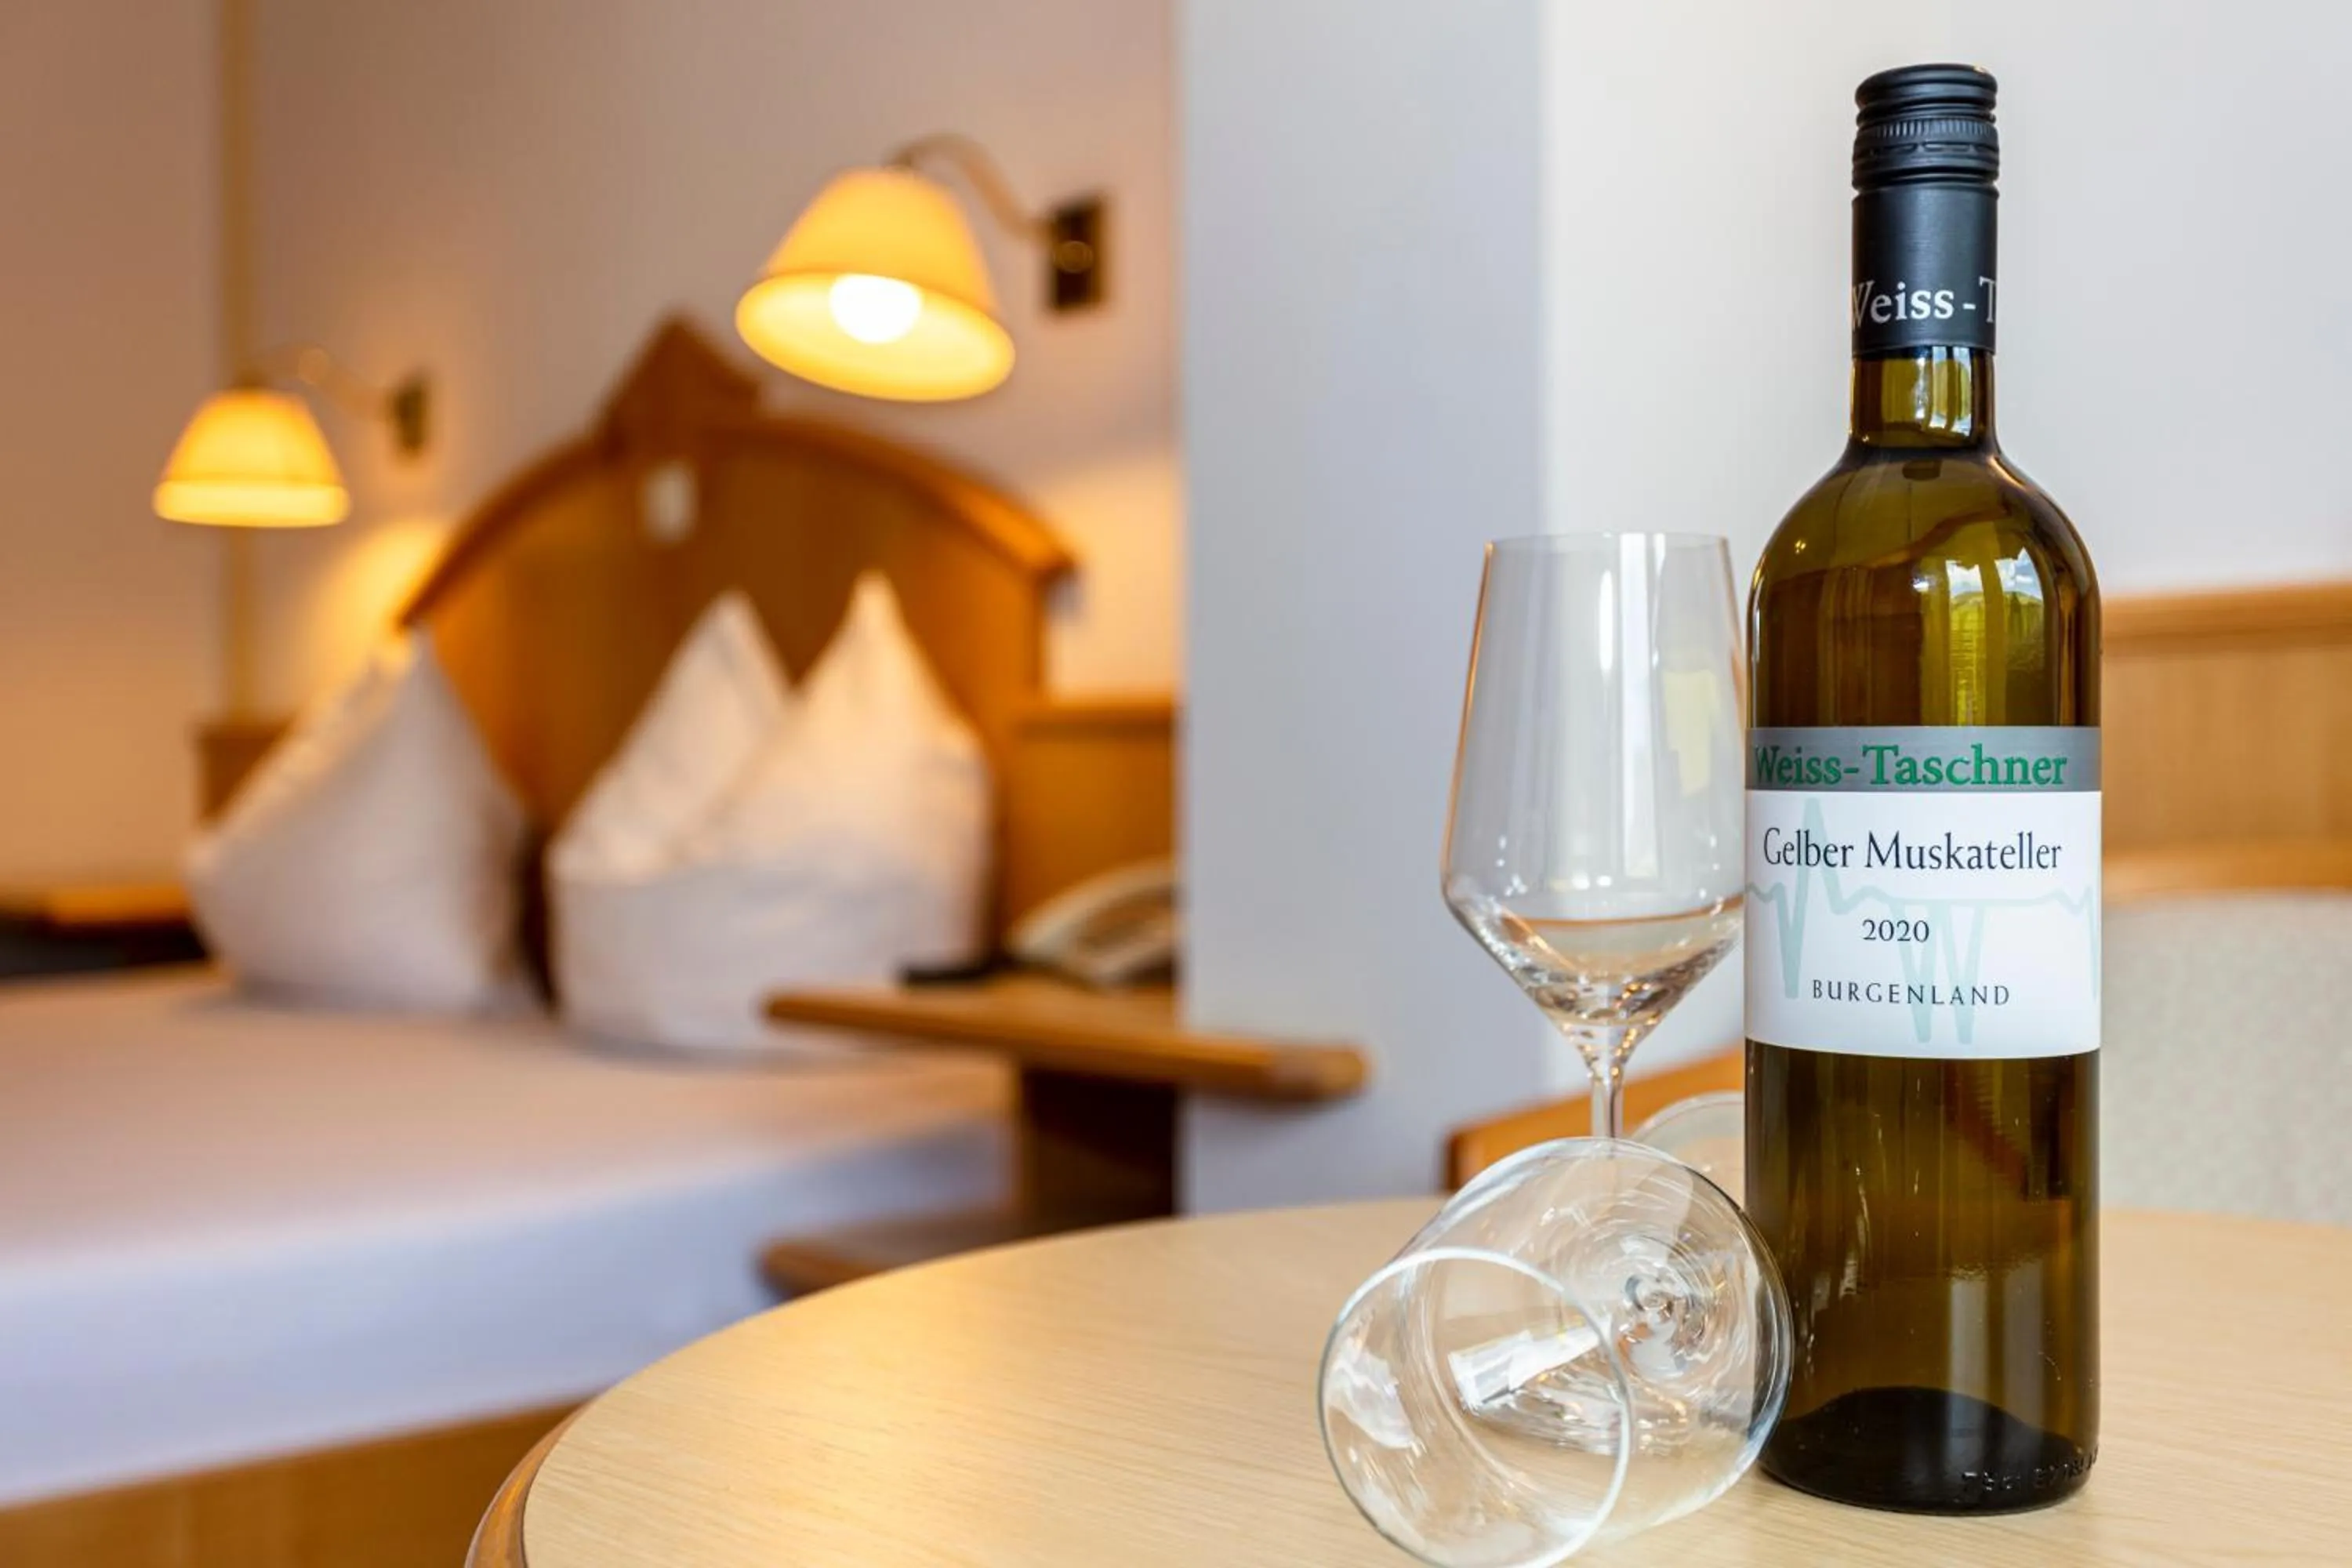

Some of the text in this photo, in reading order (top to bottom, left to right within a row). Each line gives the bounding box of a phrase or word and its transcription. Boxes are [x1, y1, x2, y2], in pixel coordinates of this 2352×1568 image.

[1754, 743, 2067, 786] Weiss-Taschner
[1763, 827, 2062, 869] Gelber Muskateller
[1862, 919, 1929, 942] 2020
[1813, 979, 2009, 1006] BURGENLAND
